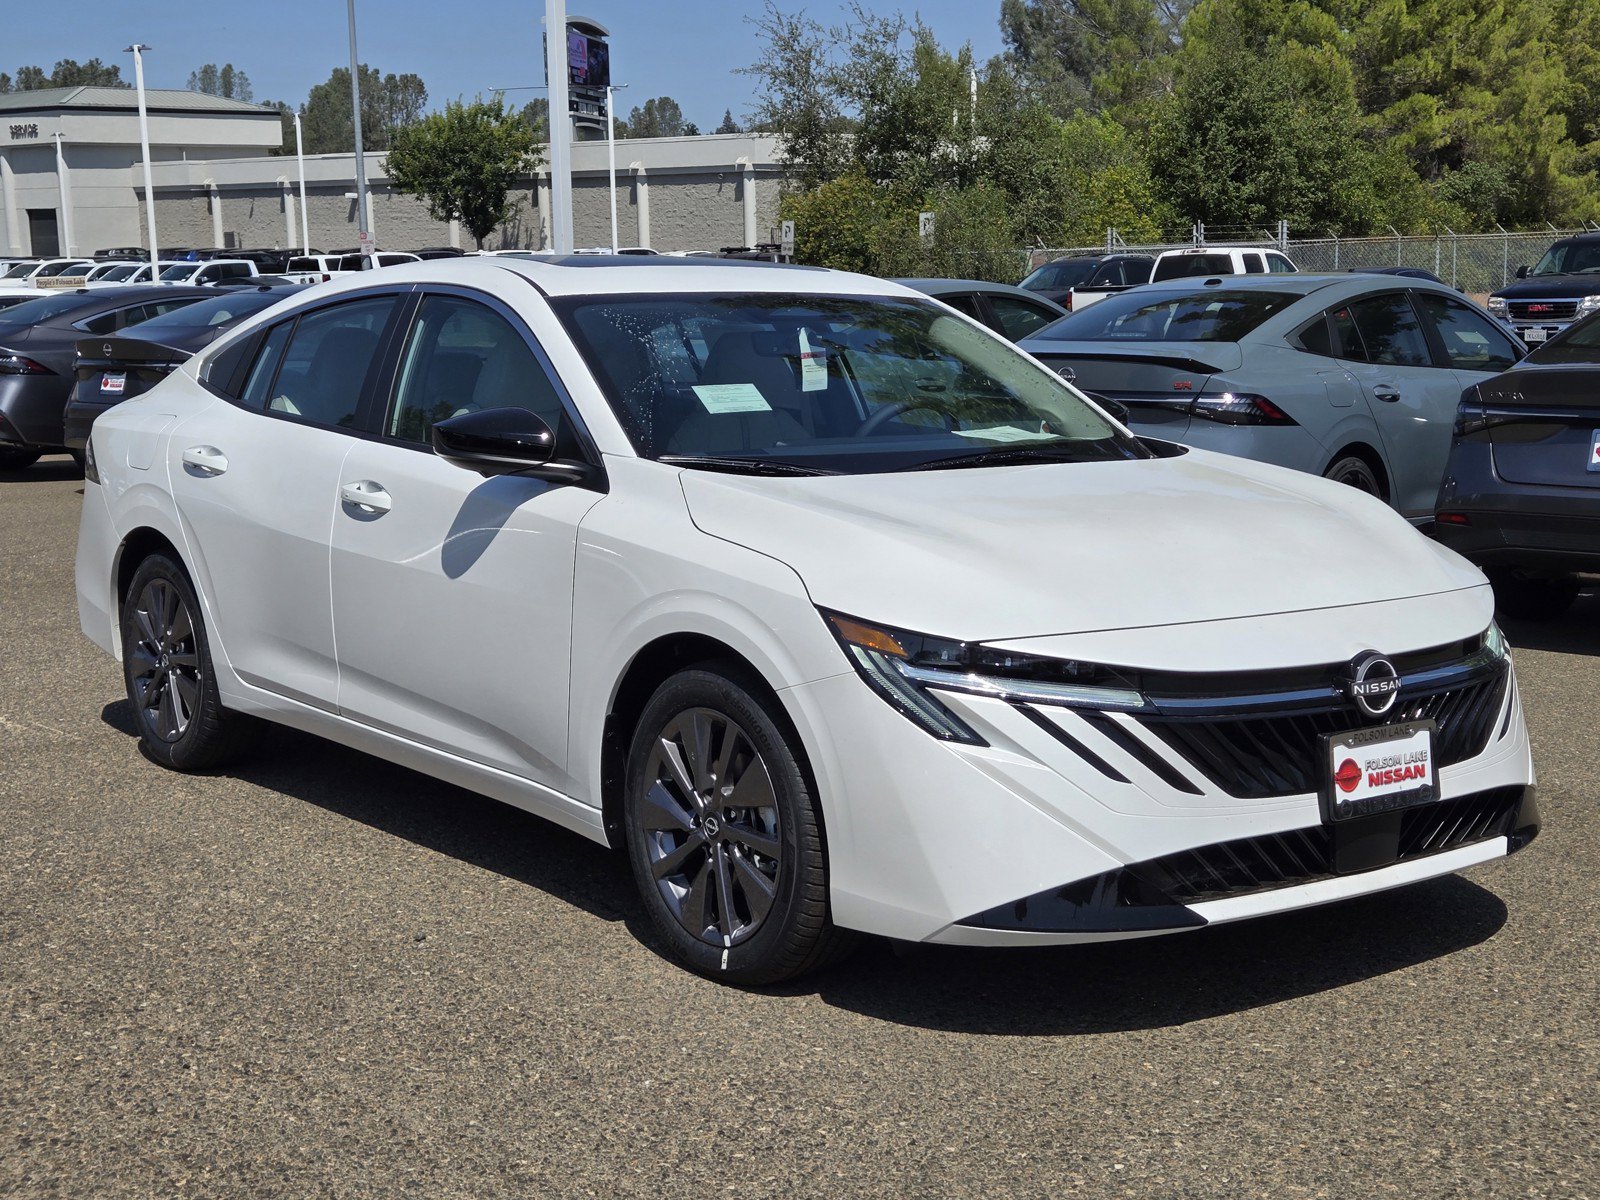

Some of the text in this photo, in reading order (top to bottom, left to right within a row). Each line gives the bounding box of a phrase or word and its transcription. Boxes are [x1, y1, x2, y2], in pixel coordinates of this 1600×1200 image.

[1528, 304, 1553, 312] GMC
[1353, 678, 1401, 694] NISSAN
[1354, 724, 1411, 742] FOLSOM LAKE
[1364, 749, 1428, 771] FOLSOM LAKE
[1368, 764, 1426, 788] NISSAN
